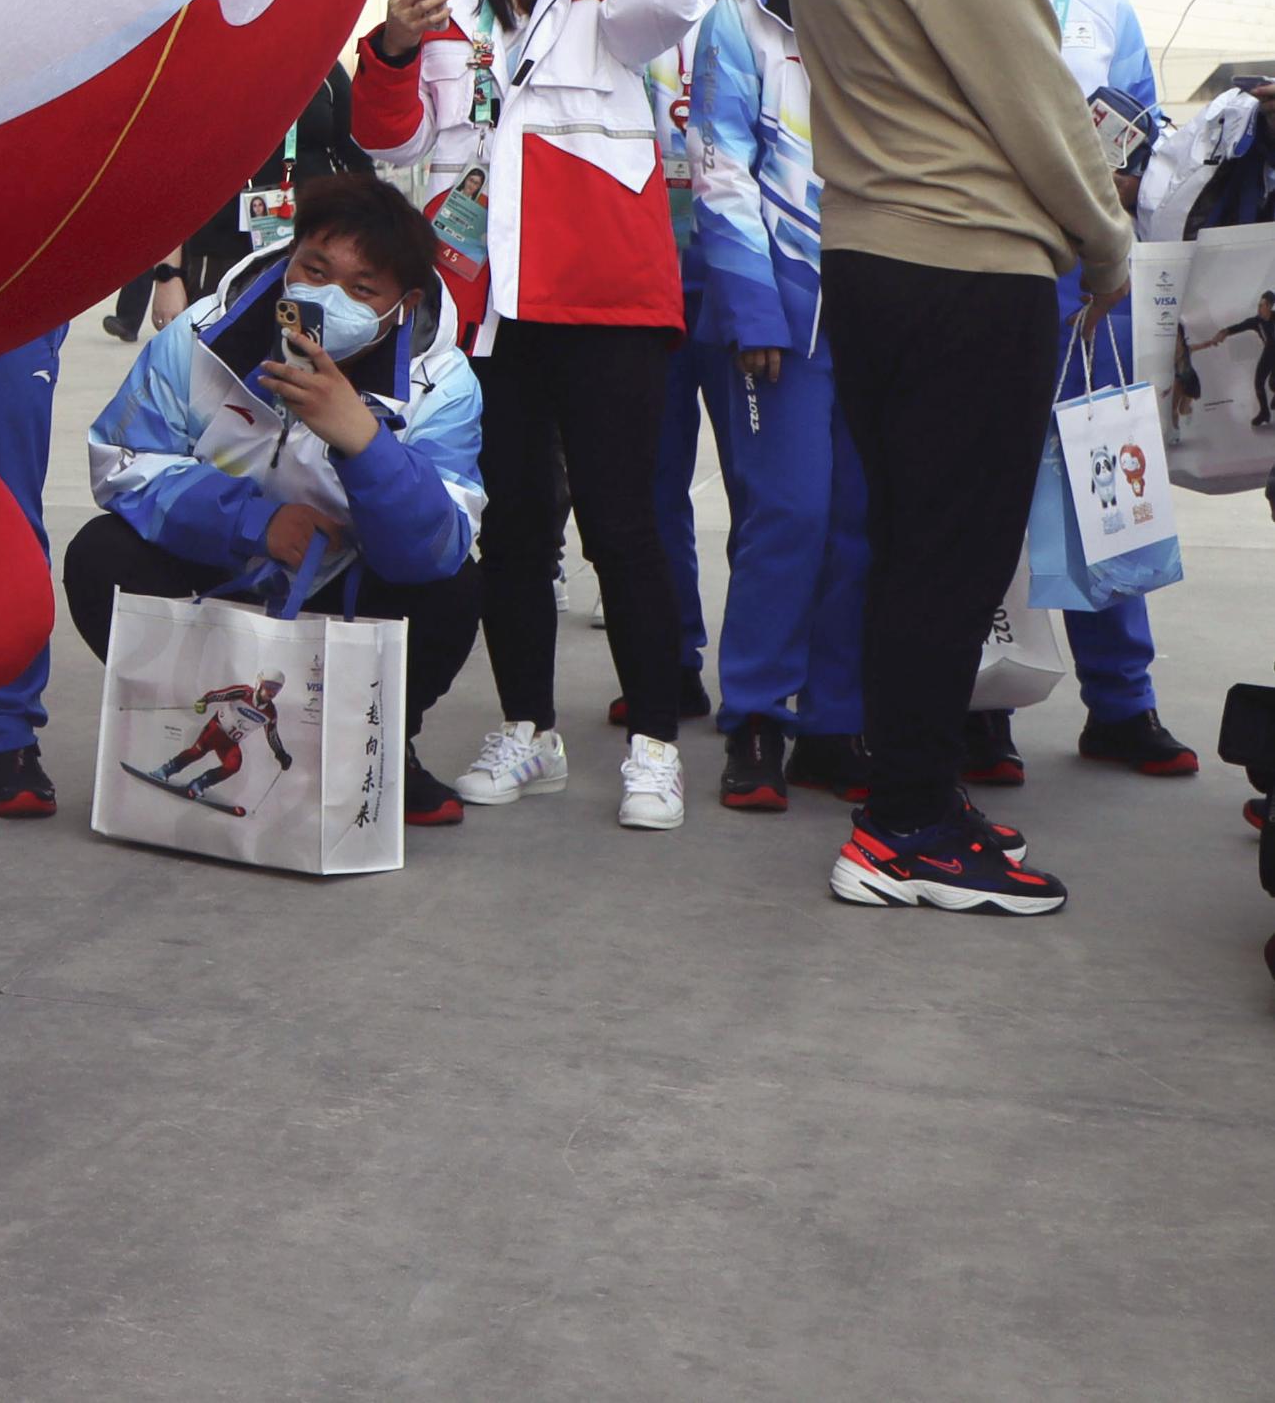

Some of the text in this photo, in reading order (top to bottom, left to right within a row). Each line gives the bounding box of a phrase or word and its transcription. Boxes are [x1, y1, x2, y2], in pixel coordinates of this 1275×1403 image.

[1154, 296, 1177, 306] VISA
[748, 394, 760, 435] 2022
[993, 608, 1014, 645] 022
[355, 681, 380, 828] 一起向未来
